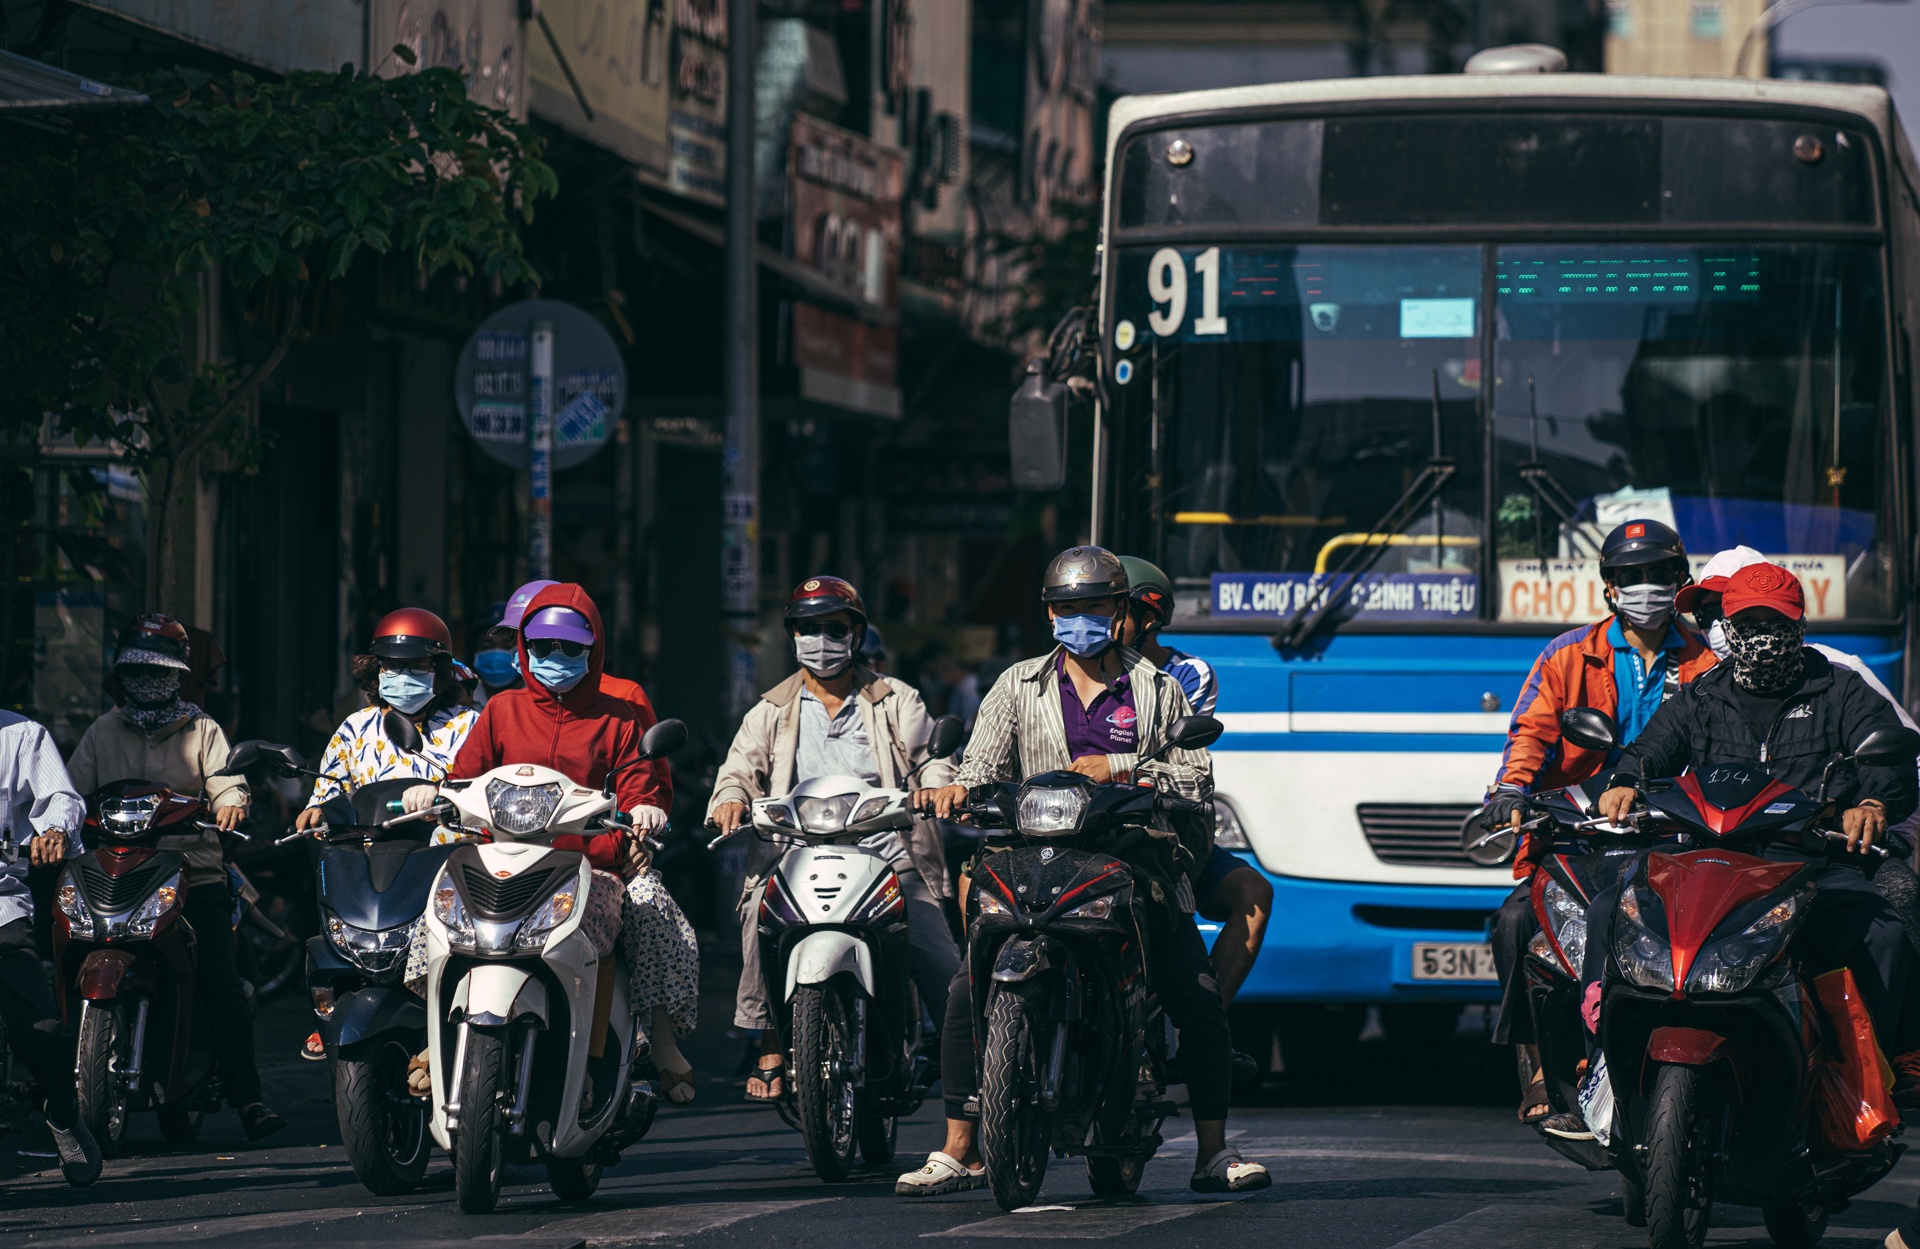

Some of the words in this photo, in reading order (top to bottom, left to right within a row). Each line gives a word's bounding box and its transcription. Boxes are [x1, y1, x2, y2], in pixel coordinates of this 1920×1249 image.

[1147, 246, 1228, 337] 91
[1252, 579, 1294, 616] CHỢ
[1418, 577, 1476, 615] TRIỆU
[1510, 575, 1576, 623] CHỢ
[1109, 727, 1134, 737] English
[1110, 734, 1132, 744] Planet
[1708, 768, 1751, 785] 134
